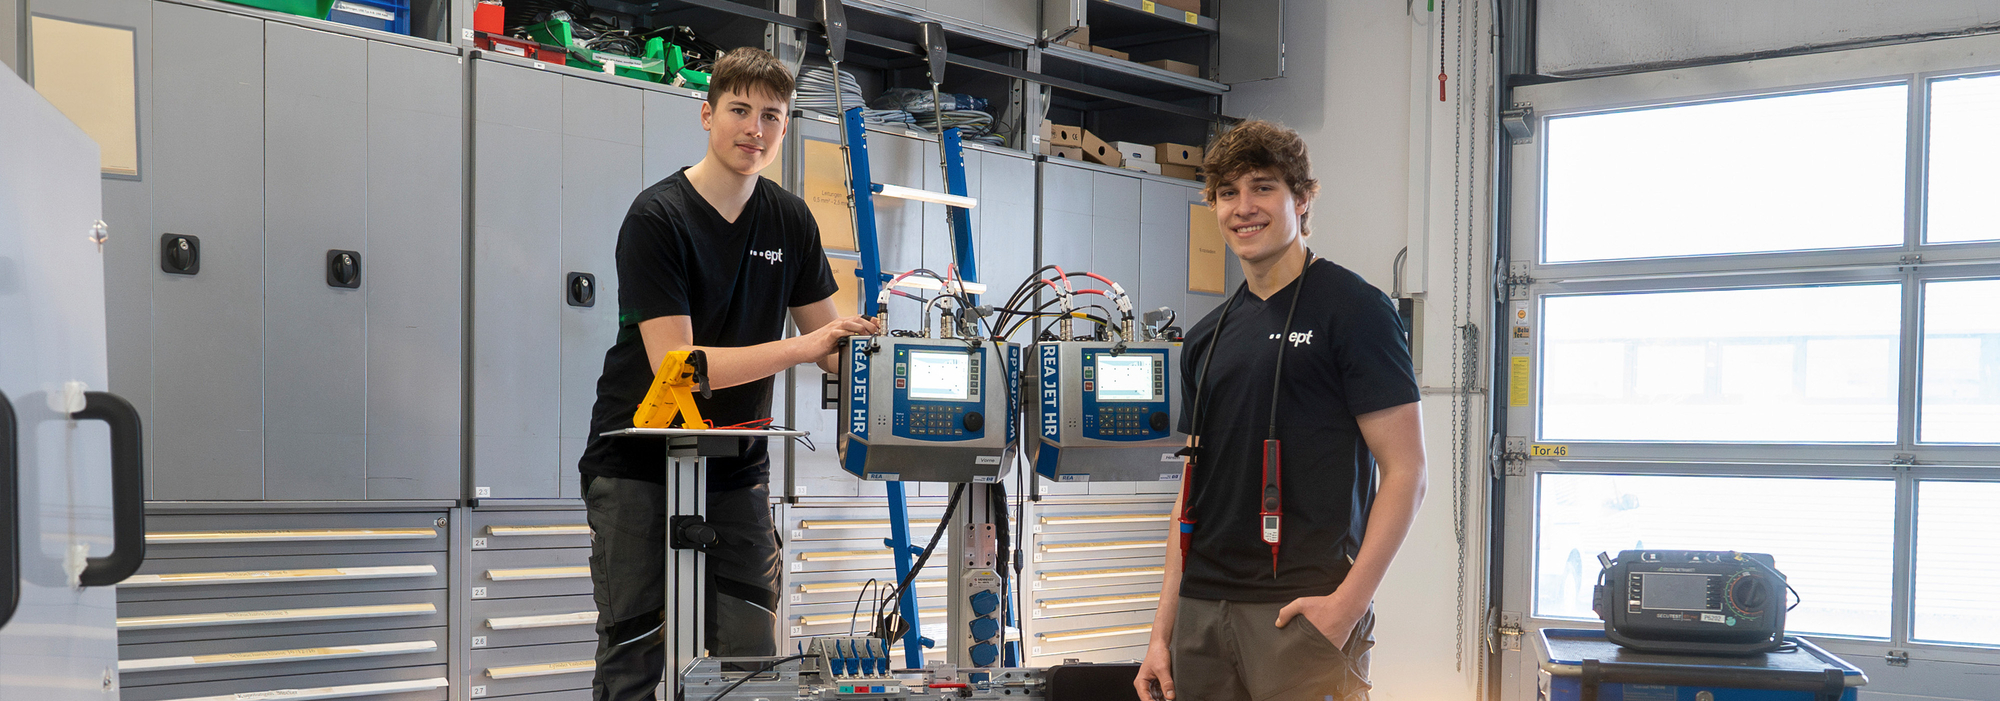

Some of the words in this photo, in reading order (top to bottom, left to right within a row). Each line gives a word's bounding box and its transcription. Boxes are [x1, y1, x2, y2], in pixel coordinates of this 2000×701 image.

[822, 190, 843, 199] Leitungen
[764, 248, 783, 265] ept
[1288, 330, 1313, 347] ept
[854, 341, 867, 373] REA
[1043, 346, 1056, 378] REA
[854, 376, 867, 404] JET
[1044, 381, 1057, 407] JET
[853, 409, 866, 433] HR
[1044, 412, 1057, 436] HR
[1533, 446, 1551, 456] Tor
[1553, 446, 1566, 456] 46
[478, 488, 488, 496] 2.3
